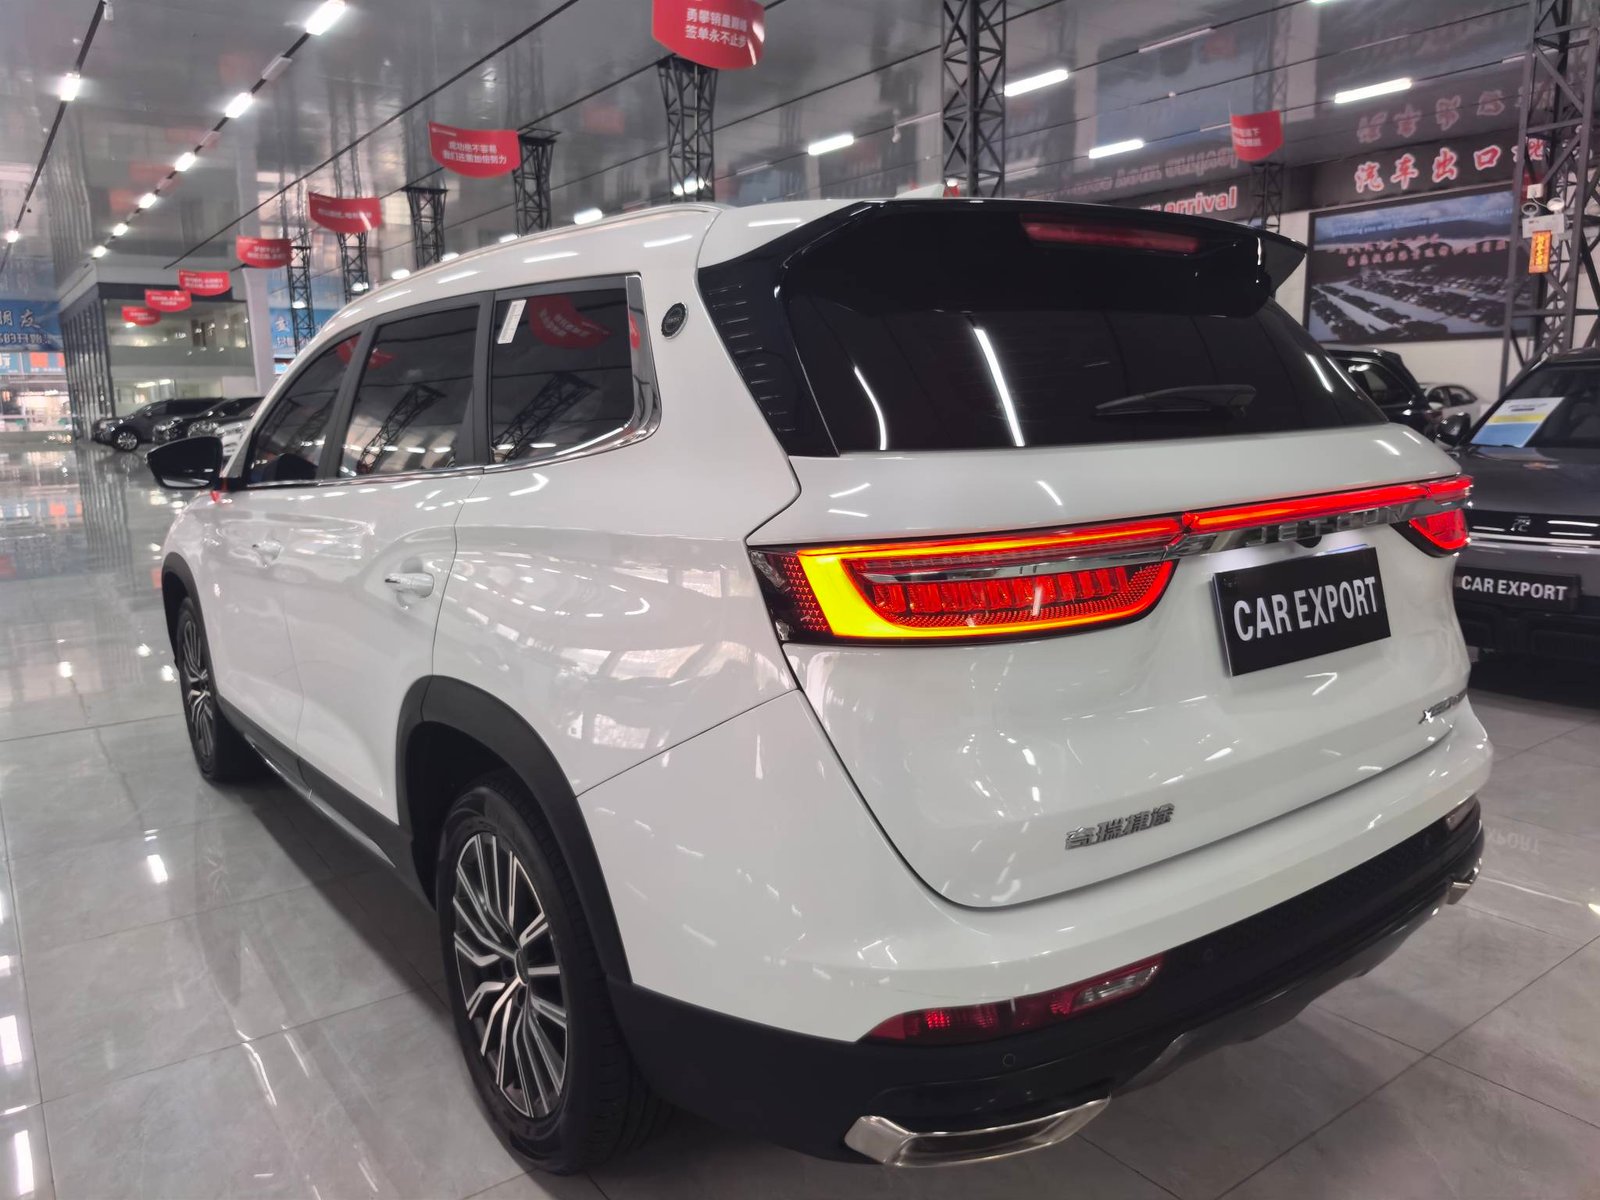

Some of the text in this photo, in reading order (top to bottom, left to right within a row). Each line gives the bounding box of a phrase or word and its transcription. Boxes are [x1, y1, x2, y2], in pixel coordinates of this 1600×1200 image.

[686, 25, 747, 48] 签单永不止步
[1462, 575, 1568, 601] CAR EXPORT
[1233, 576, 1378, 642] CAR EXPORT
[1065, 803, 1175, 850] 奇瑞捷途
